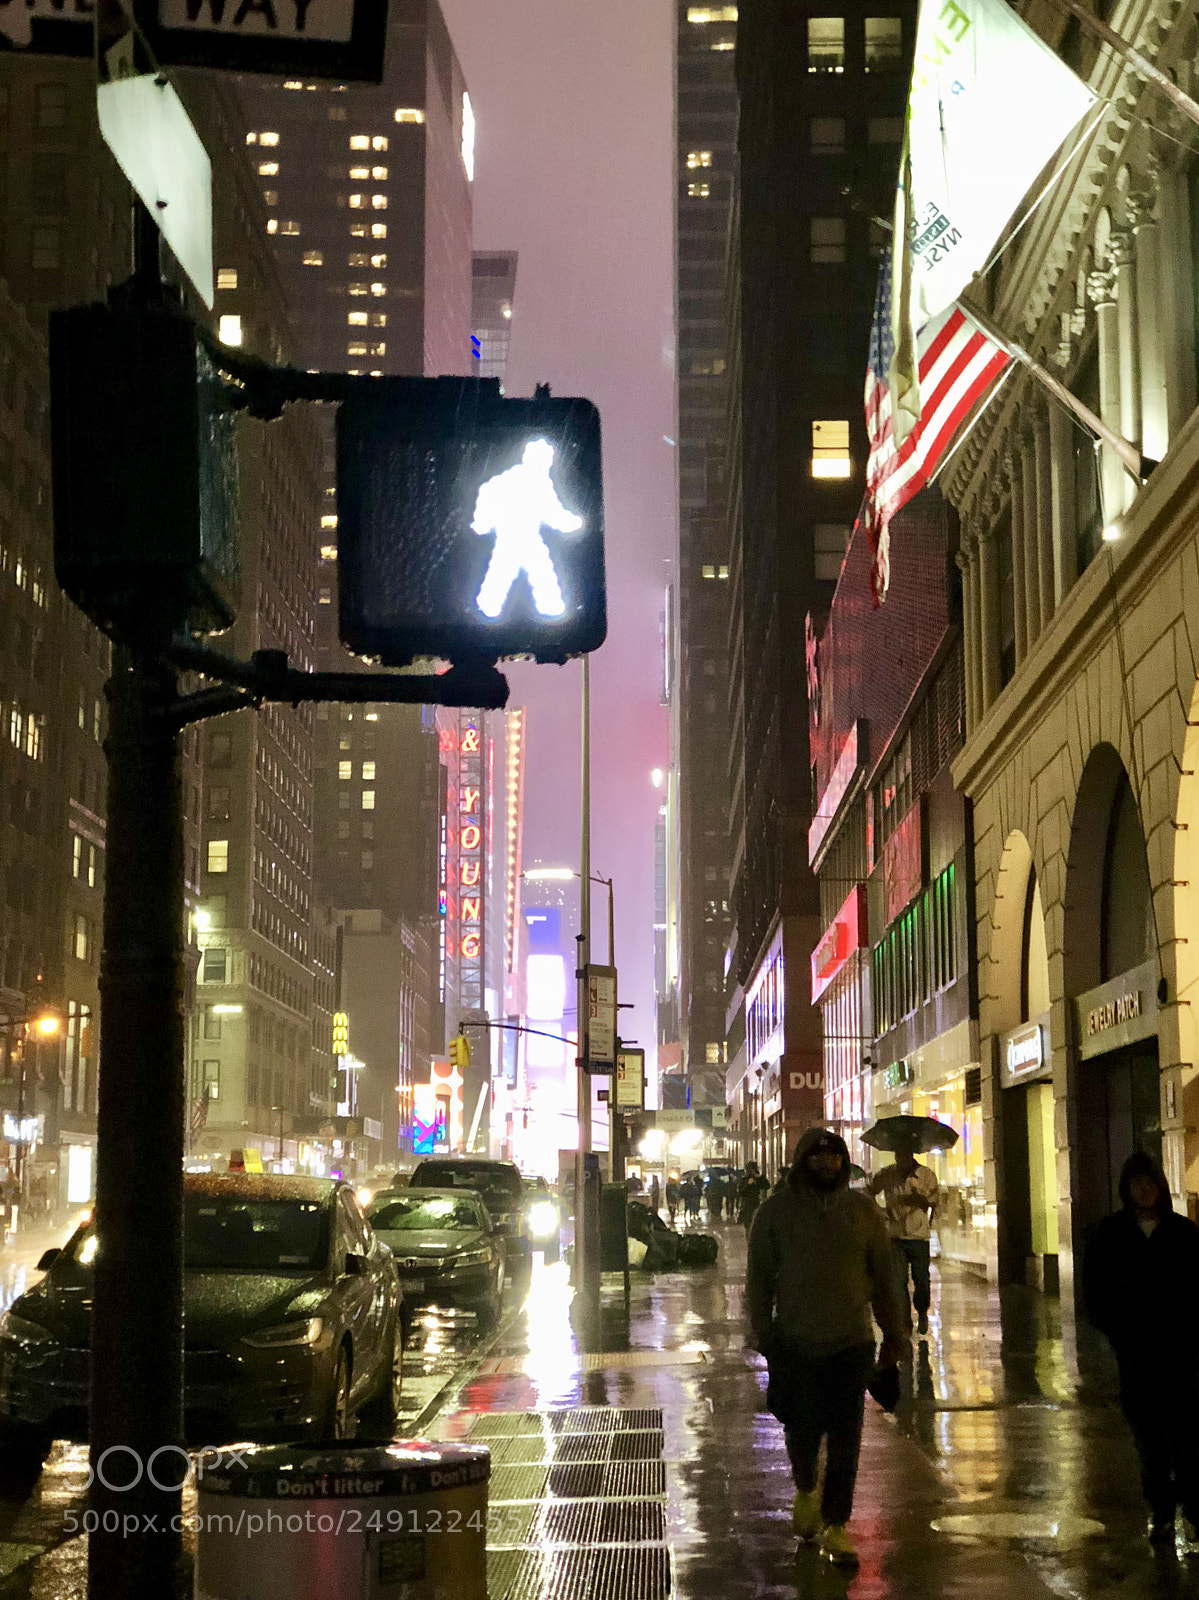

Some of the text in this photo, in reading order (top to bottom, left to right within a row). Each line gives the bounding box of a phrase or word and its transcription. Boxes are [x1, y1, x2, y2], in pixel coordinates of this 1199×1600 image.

[461, 787, 480, 957] YOUNG
[789, 1071, 823, 1090] DU
[276, 1478, 384, 1495] Don't litter
